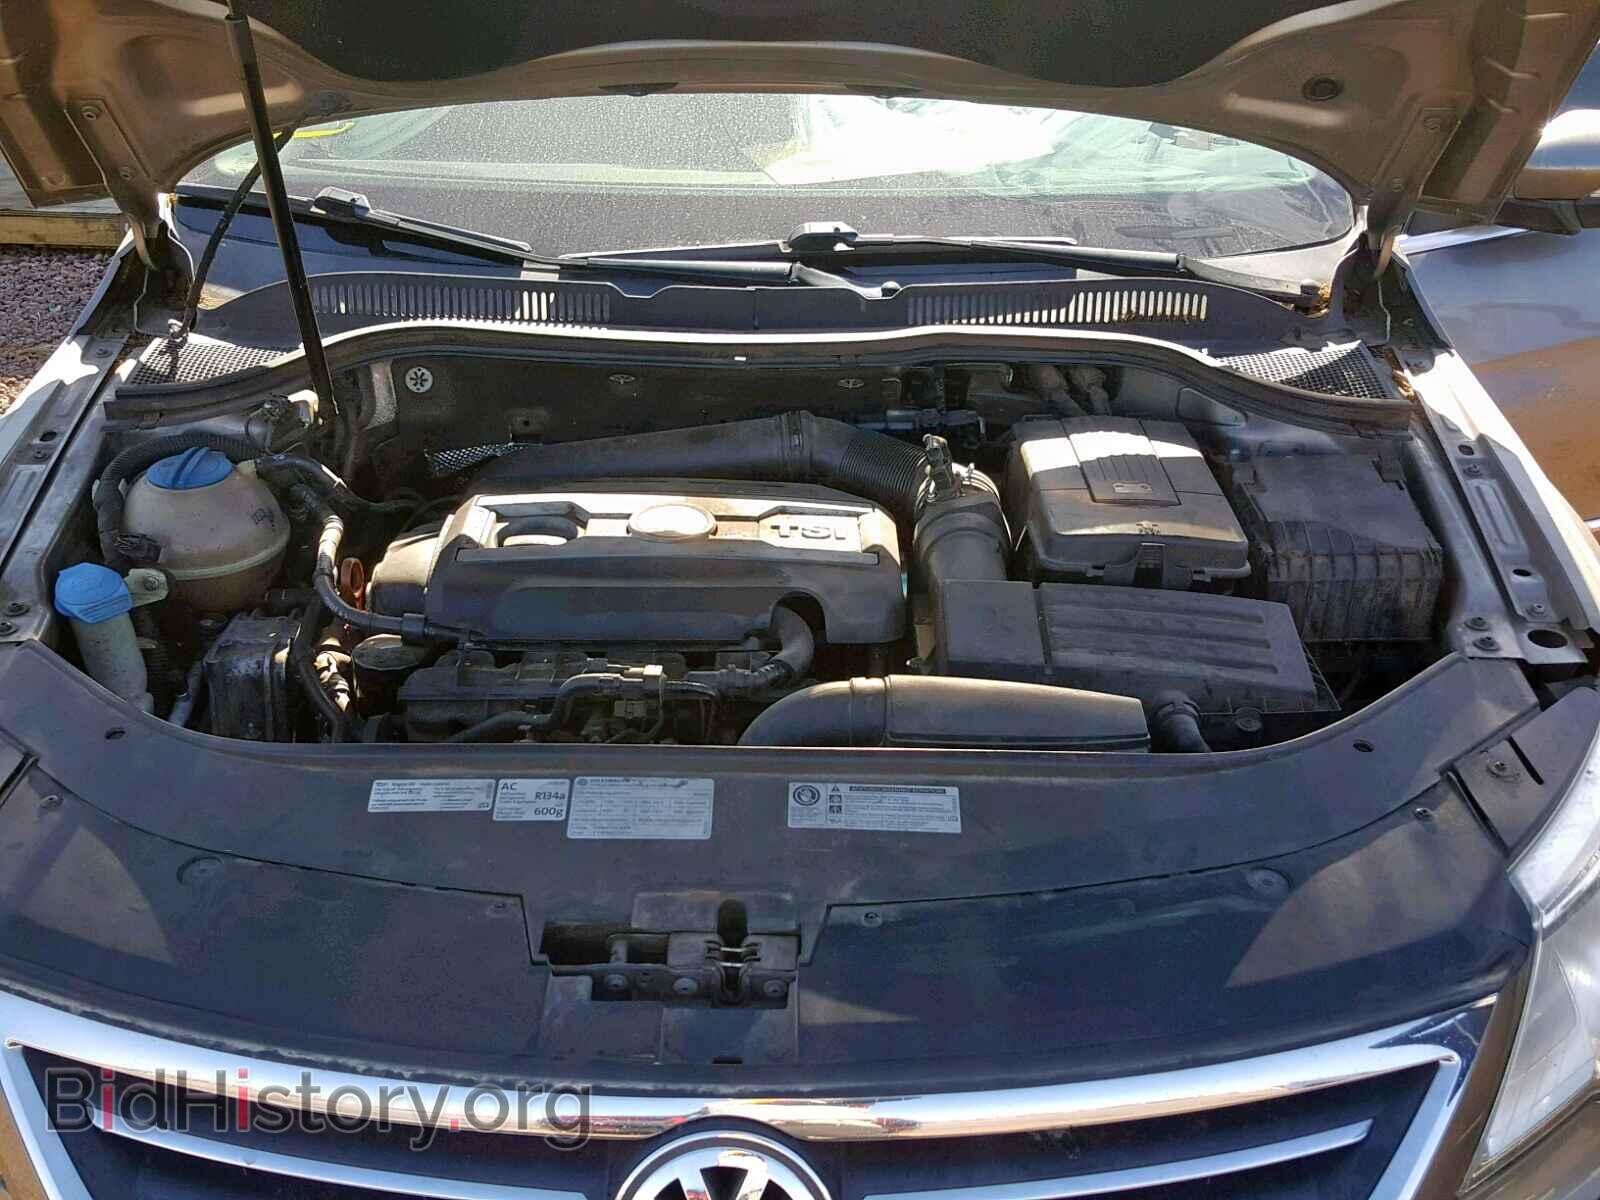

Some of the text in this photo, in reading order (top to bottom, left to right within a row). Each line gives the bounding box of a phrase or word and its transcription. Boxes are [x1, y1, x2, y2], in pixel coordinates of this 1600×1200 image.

[769, 522, 848, 540] TSI
[501, 782, 518, 790] AC
[534, 791, 566, 800] R134a
[534, 807, 564, 818] 600g
